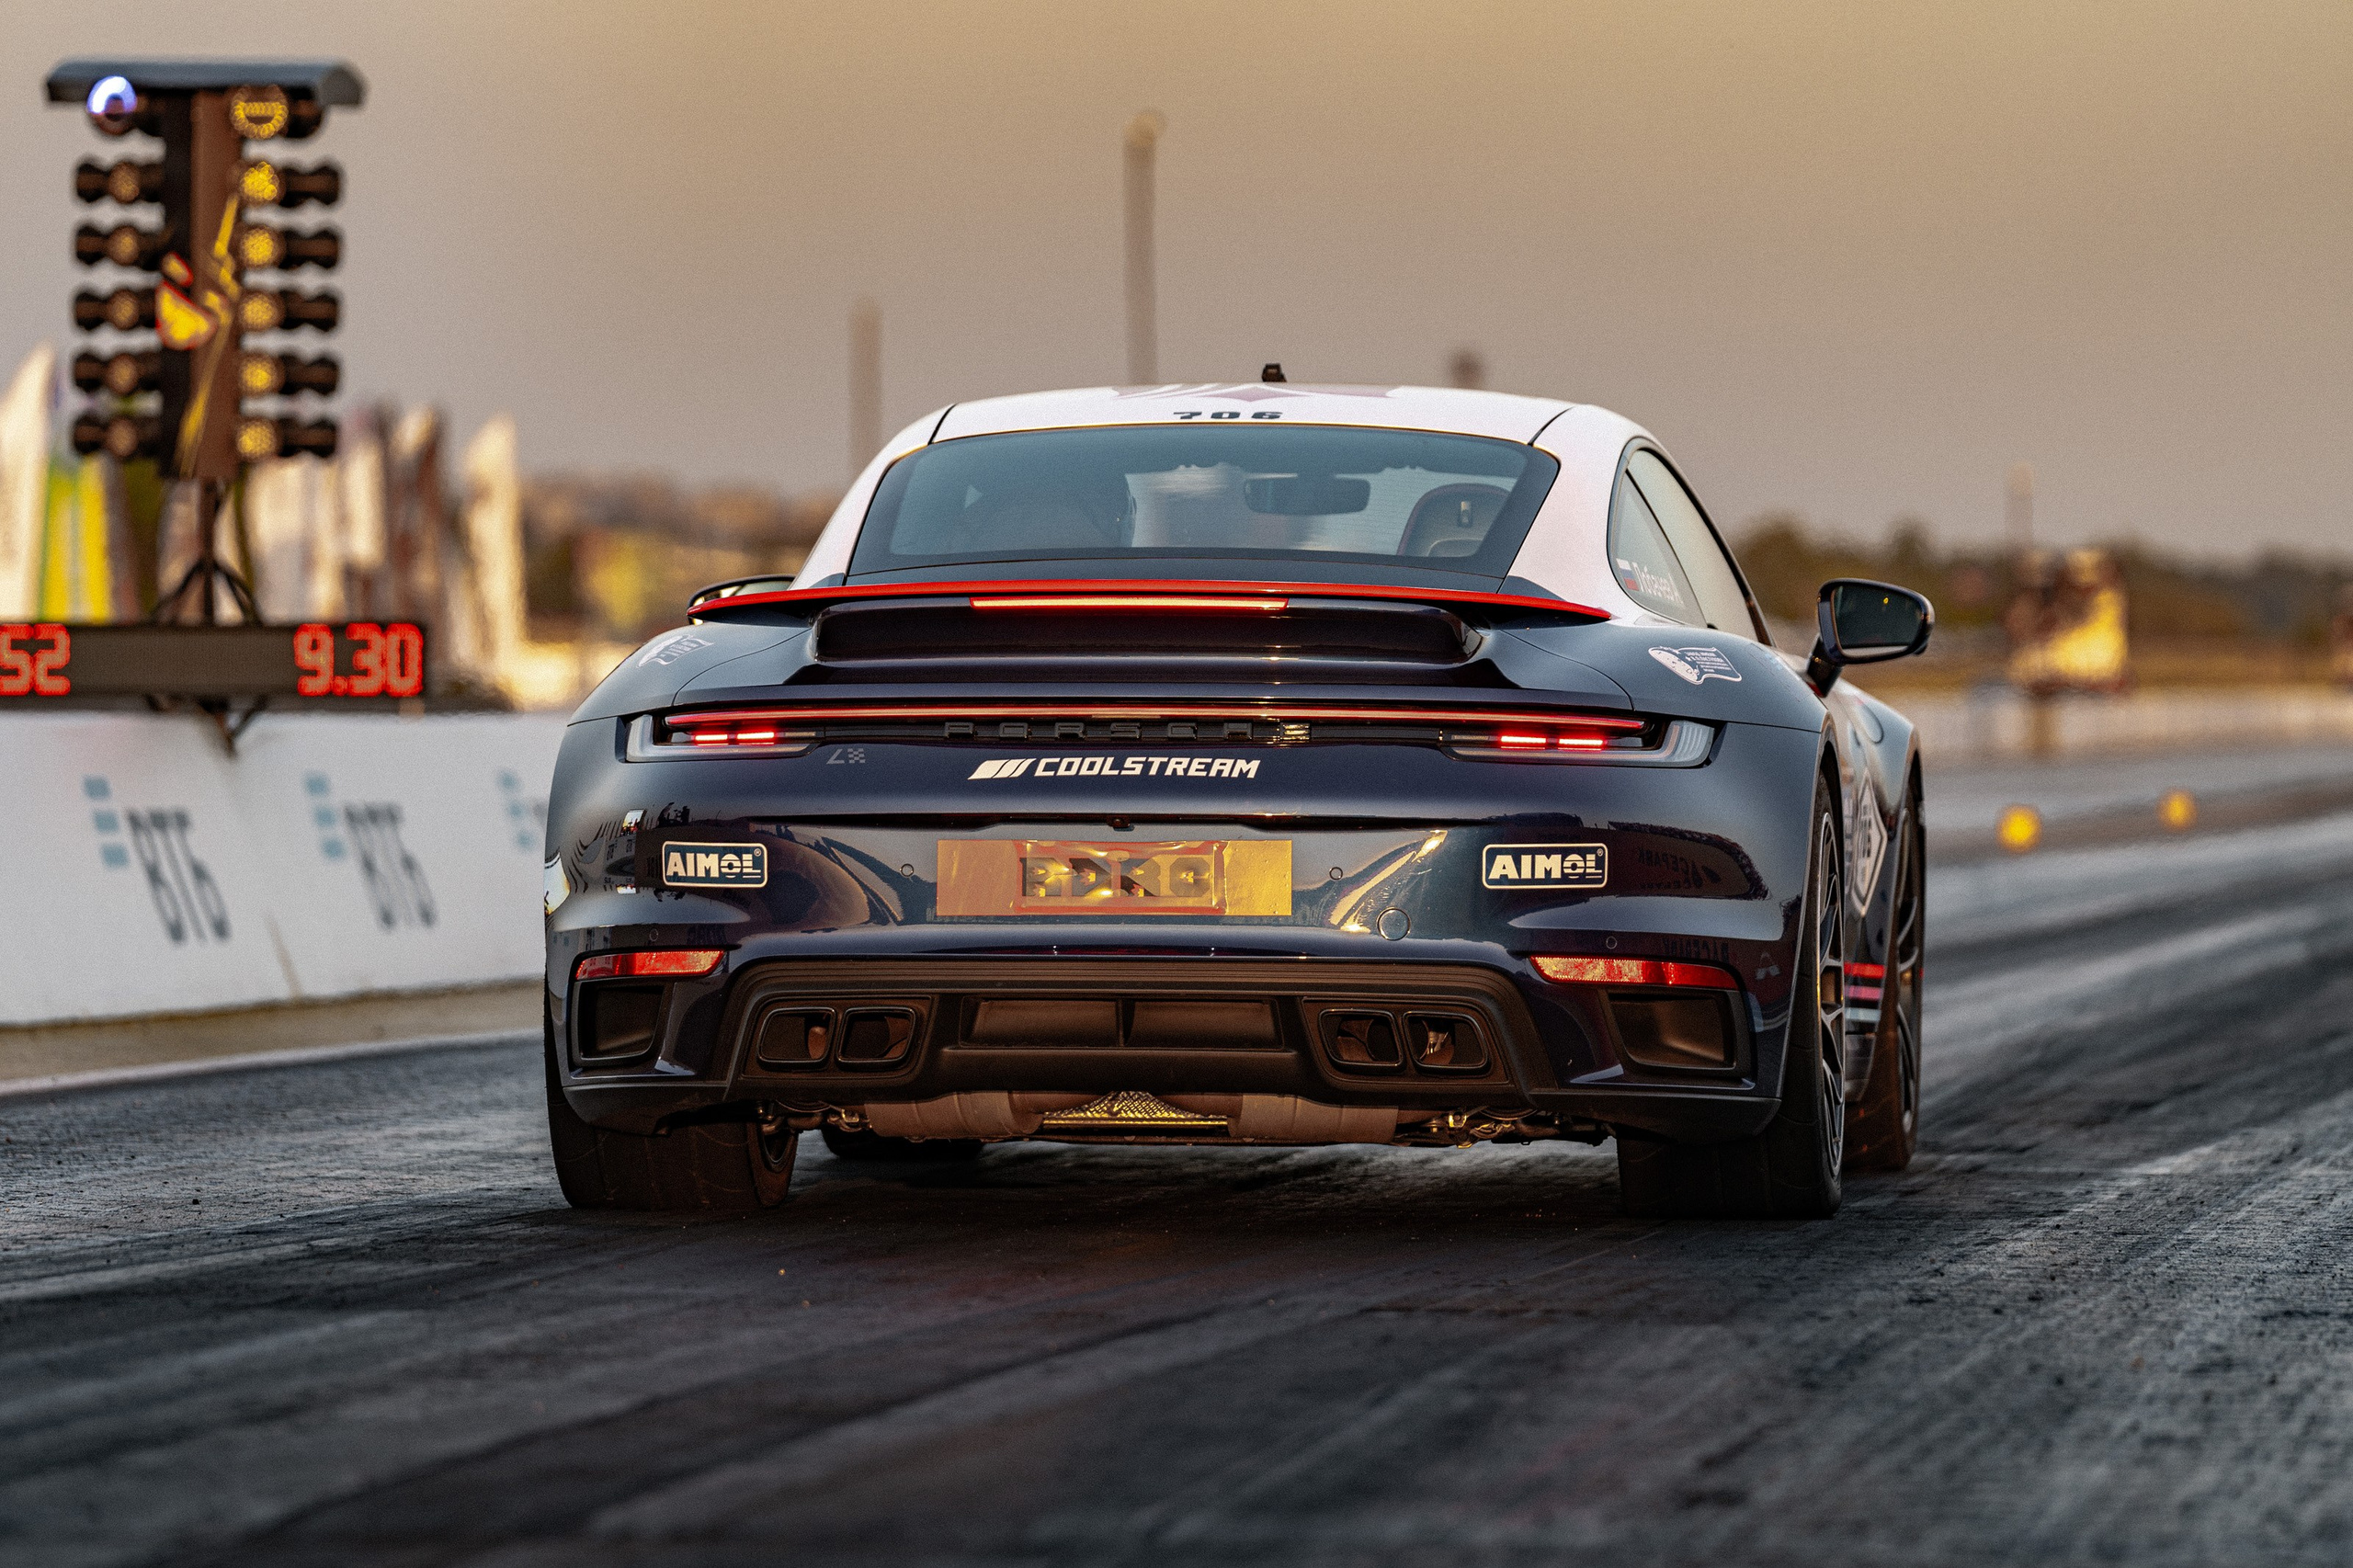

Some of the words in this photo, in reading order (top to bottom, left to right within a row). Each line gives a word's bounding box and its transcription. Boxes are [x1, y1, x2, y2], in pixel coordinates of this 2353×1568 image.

[1174, 411, 1282, 419] 706
[293, 623, 424, 697] 9.30
[1034, 756, 1261, 778] COOLSTREAM
[665, 851, 762, 879] AIMOL
[1488, 853, 1603, 880] AIMOL
